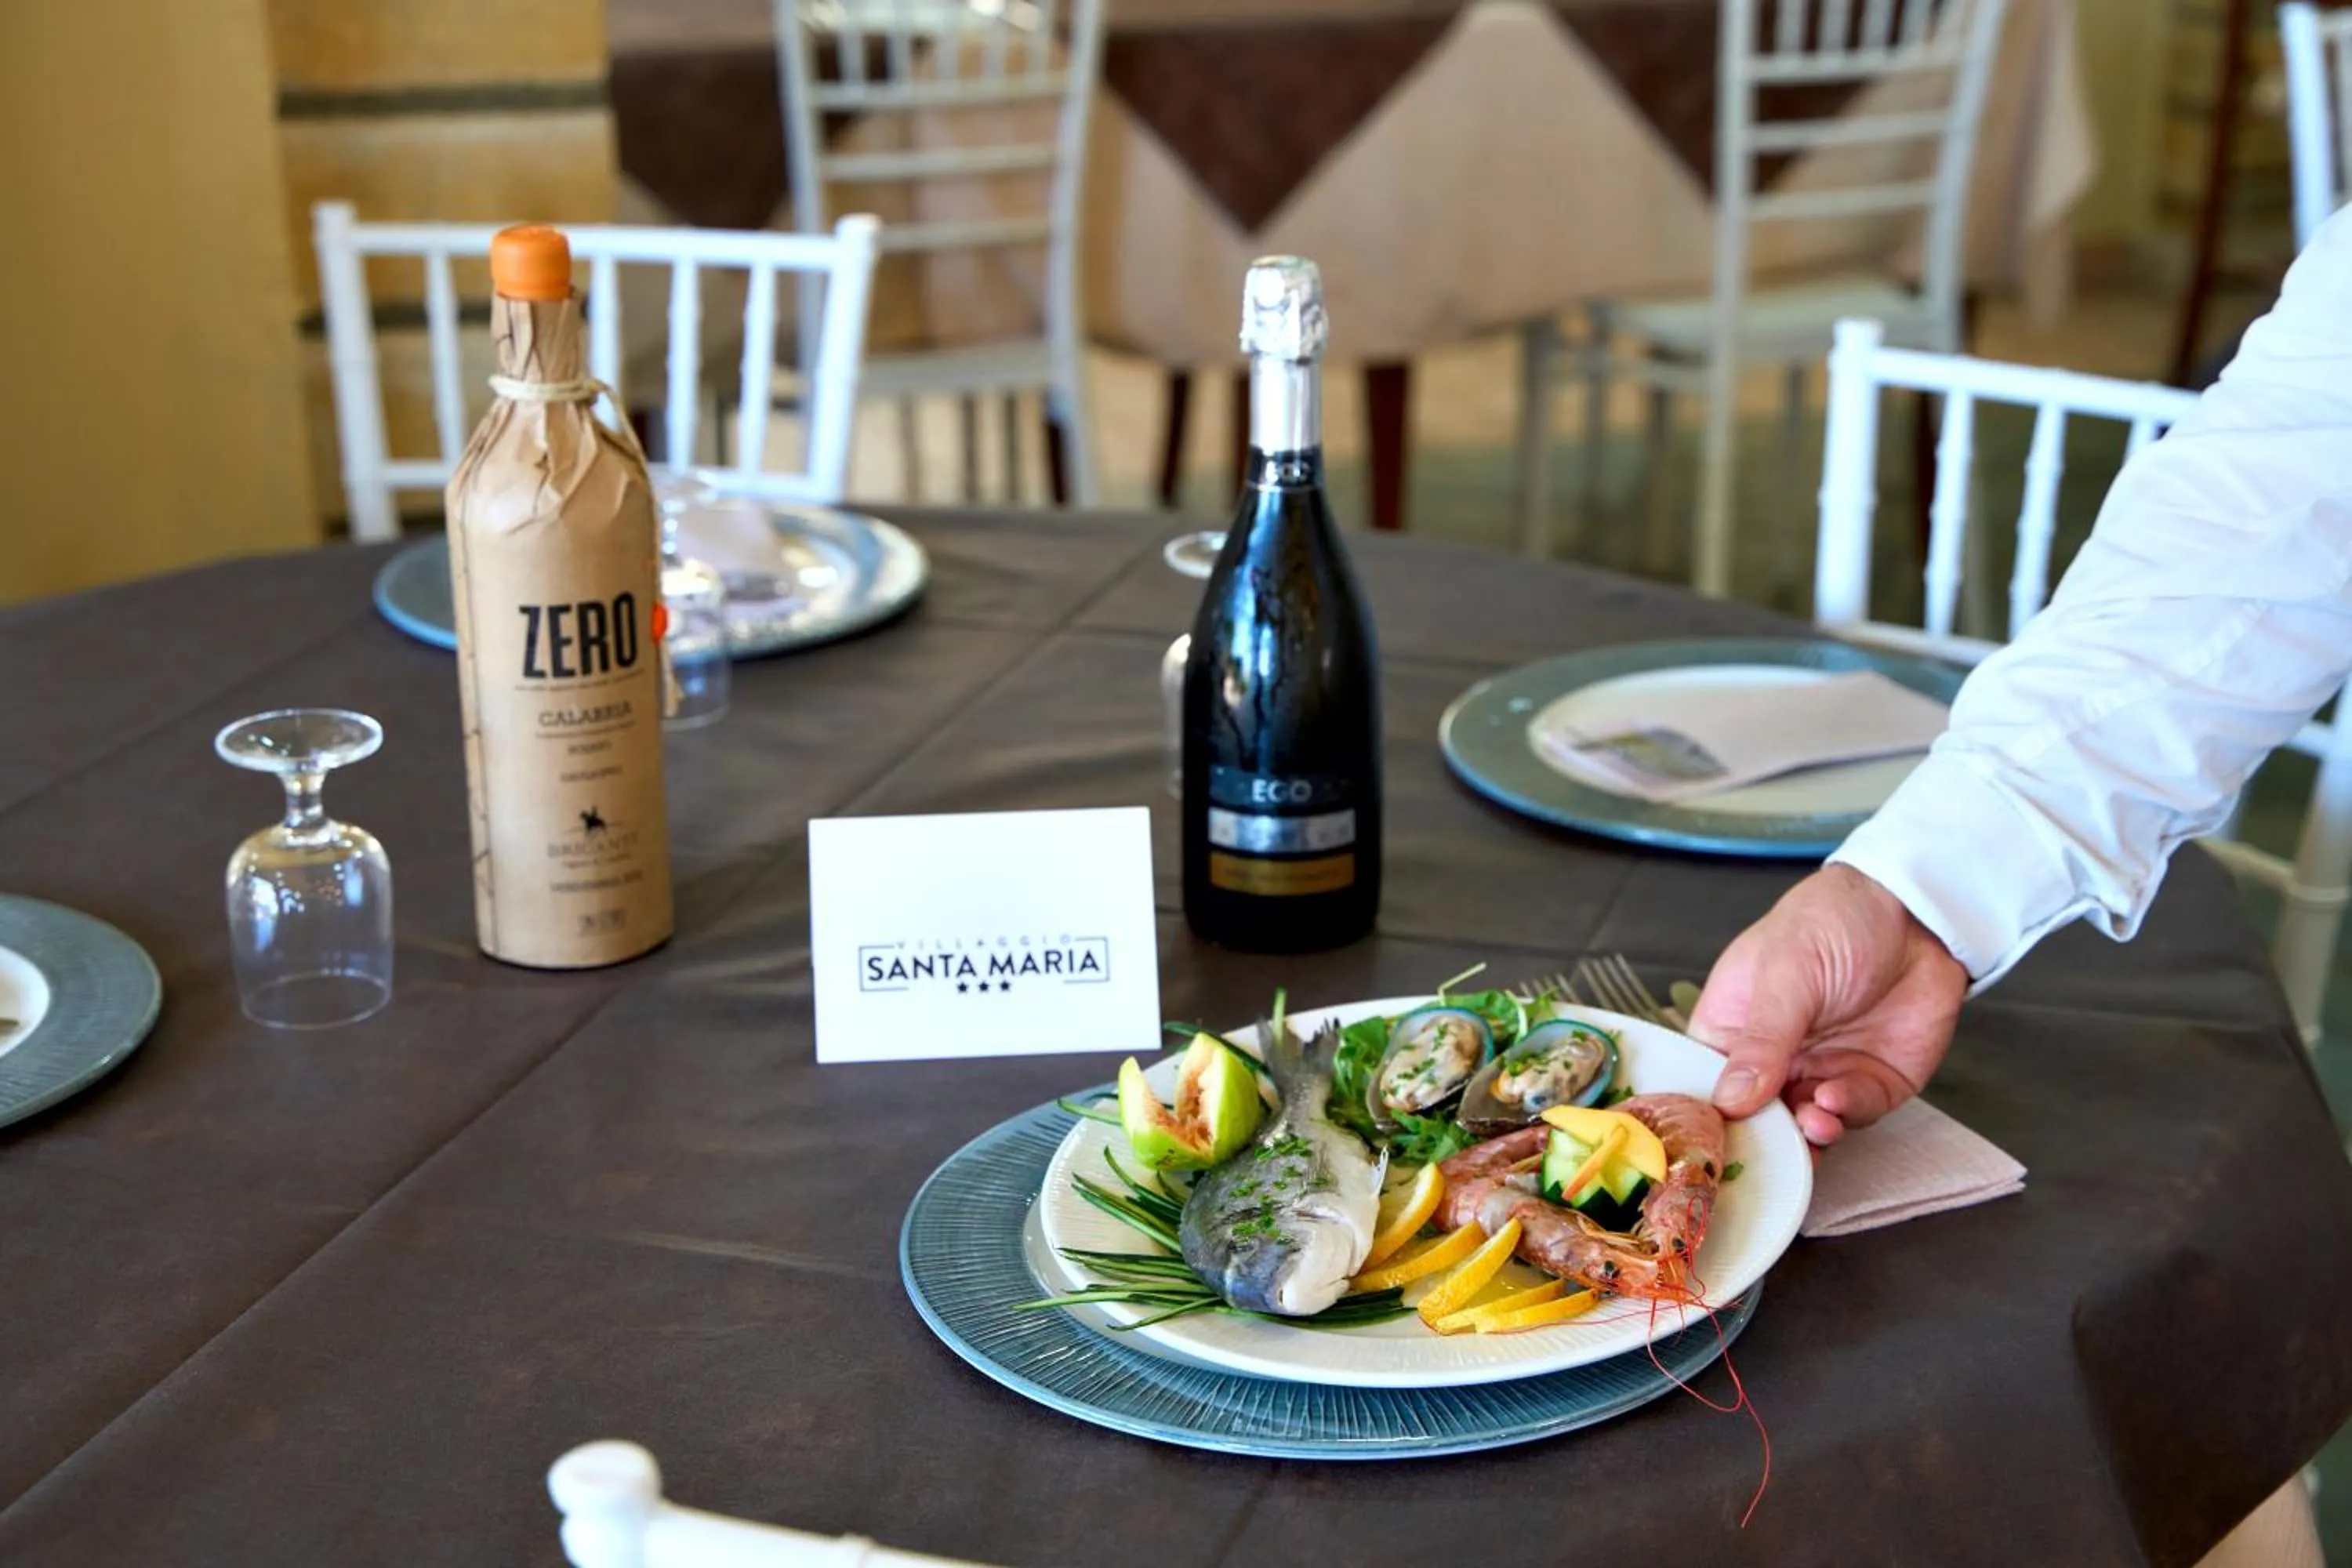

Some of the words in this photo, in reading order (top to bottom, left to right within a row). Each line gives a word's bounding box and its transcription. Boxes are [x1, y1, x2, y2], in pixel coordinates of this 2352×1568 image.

[518, 591, 638, 679] ZERO
[897, 934, 1072, 950] VILLAGGIO
[867, 956, 977, 982] SANTA
[989, 949, 1101, 977] MARIA
